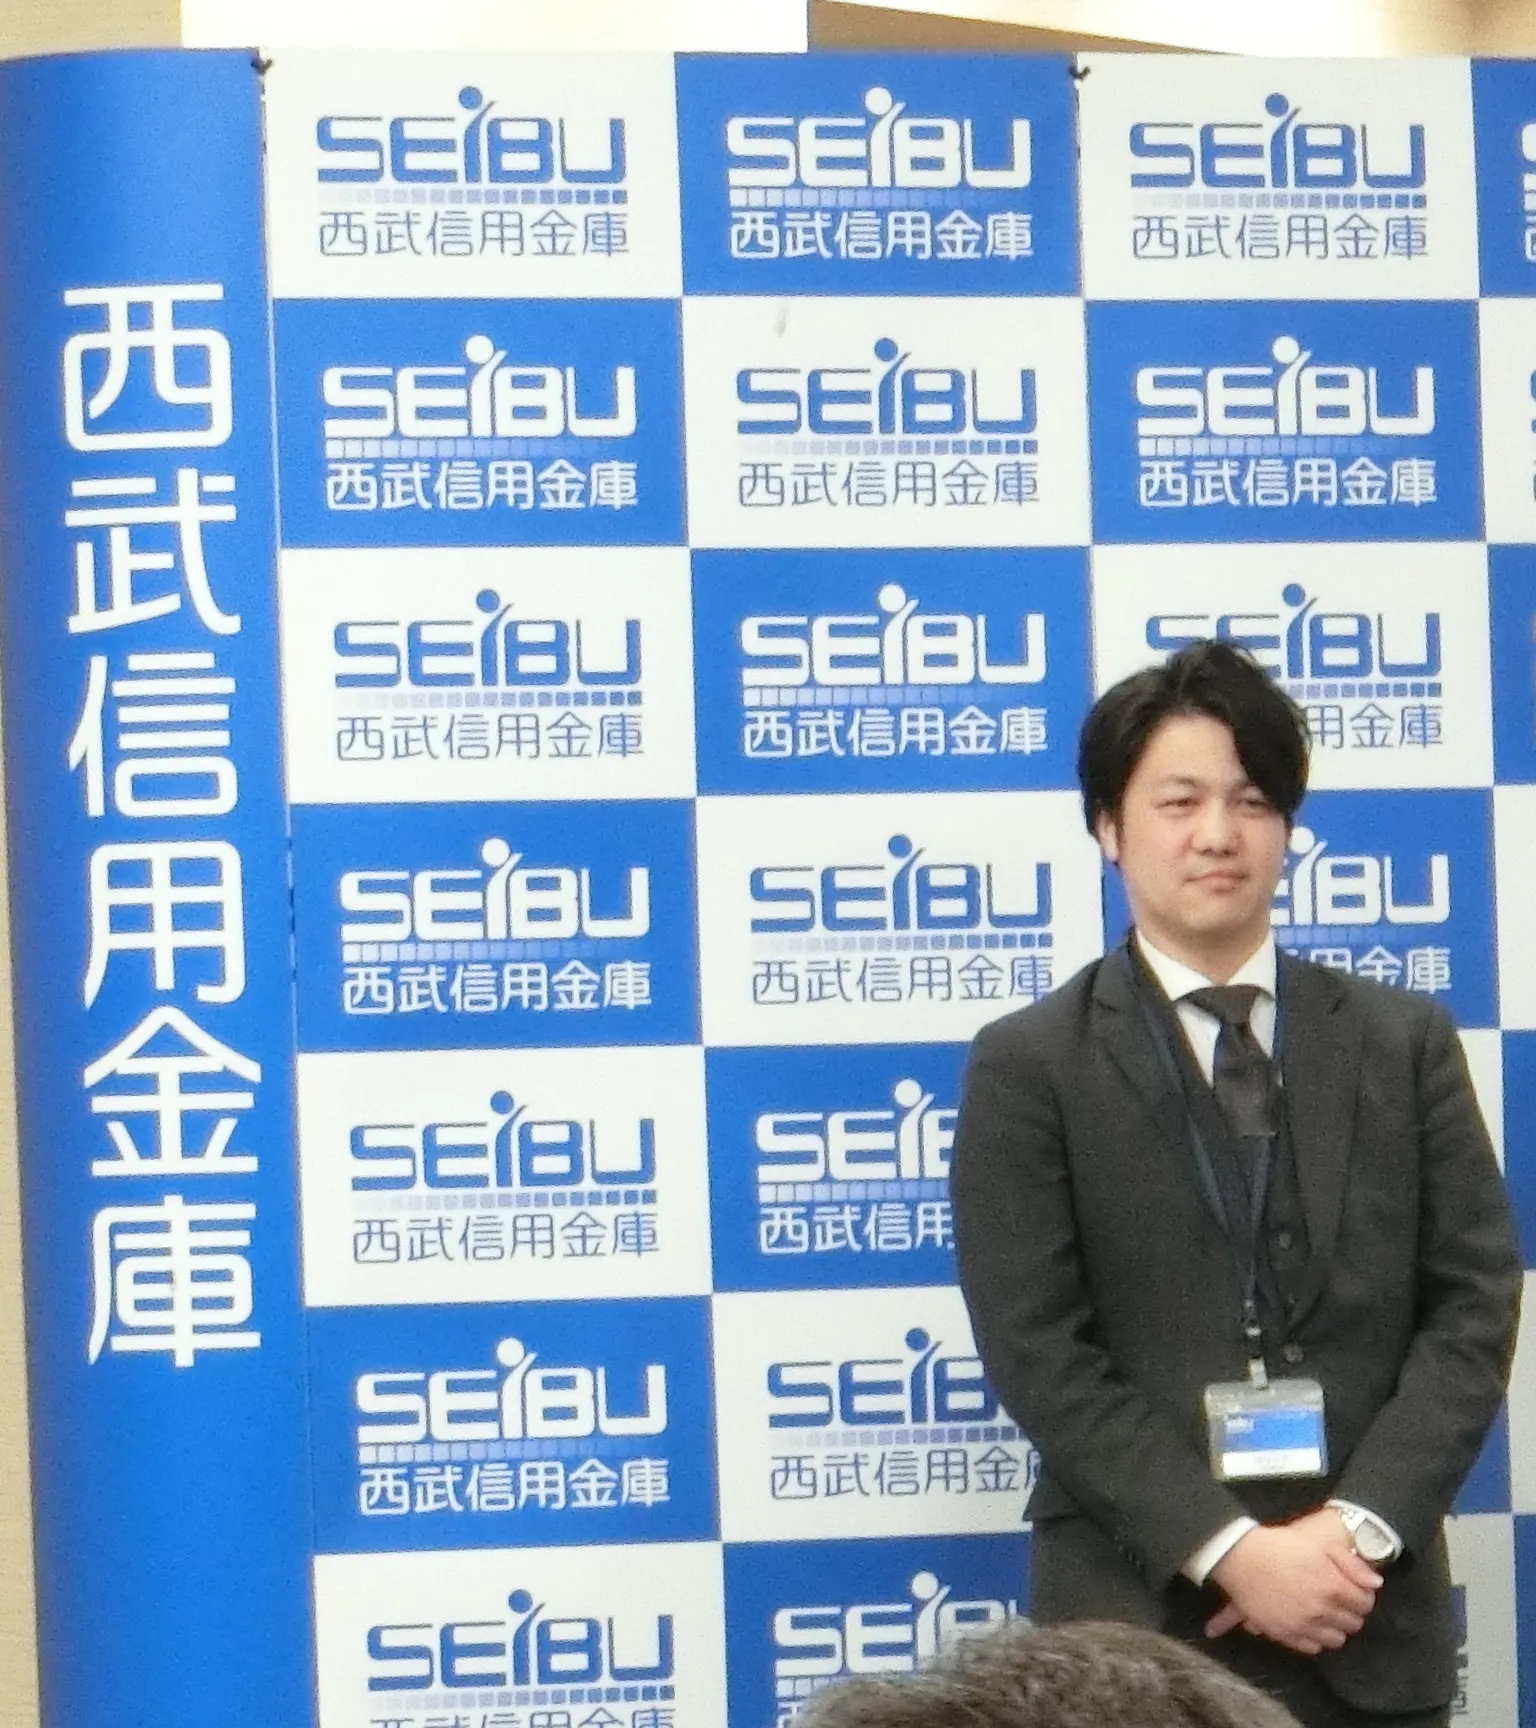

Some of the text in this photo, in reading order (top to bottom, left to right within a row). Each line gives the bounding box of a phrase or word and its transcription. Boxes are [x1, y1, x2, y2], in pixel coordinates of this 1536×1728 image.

[320, 209, 628, 257] 西武信用金庫
[730, 210, 1032, 259] 西武信用金庫
[1133, 213, 1427, 260] 西武信用金庫
[326, 459, 637, 510] 西武信用金庫
[739, 459, 1038, 507] 西武信用金庫
[1139, 457, 1436, 507] 西武信用金庫
[337, 711, 643, 761] 西武信用金庫
[744, 706, 1047, 757] 西武信用金庫
[1303, 702, 1444, 750] 用金庫
[62, 283, 262, 1368] 西武信用金庫
[343, 960, 651, 1014] 西武信用金庫
[753, 954, 1053, 1007] 西武信用金庫
[353, 1211, 658, 1263] 西武信用金庫
[759, 1200, 955, 1255] 西武信用
[359, 1458, 669, 1515] 西武信用金庫
